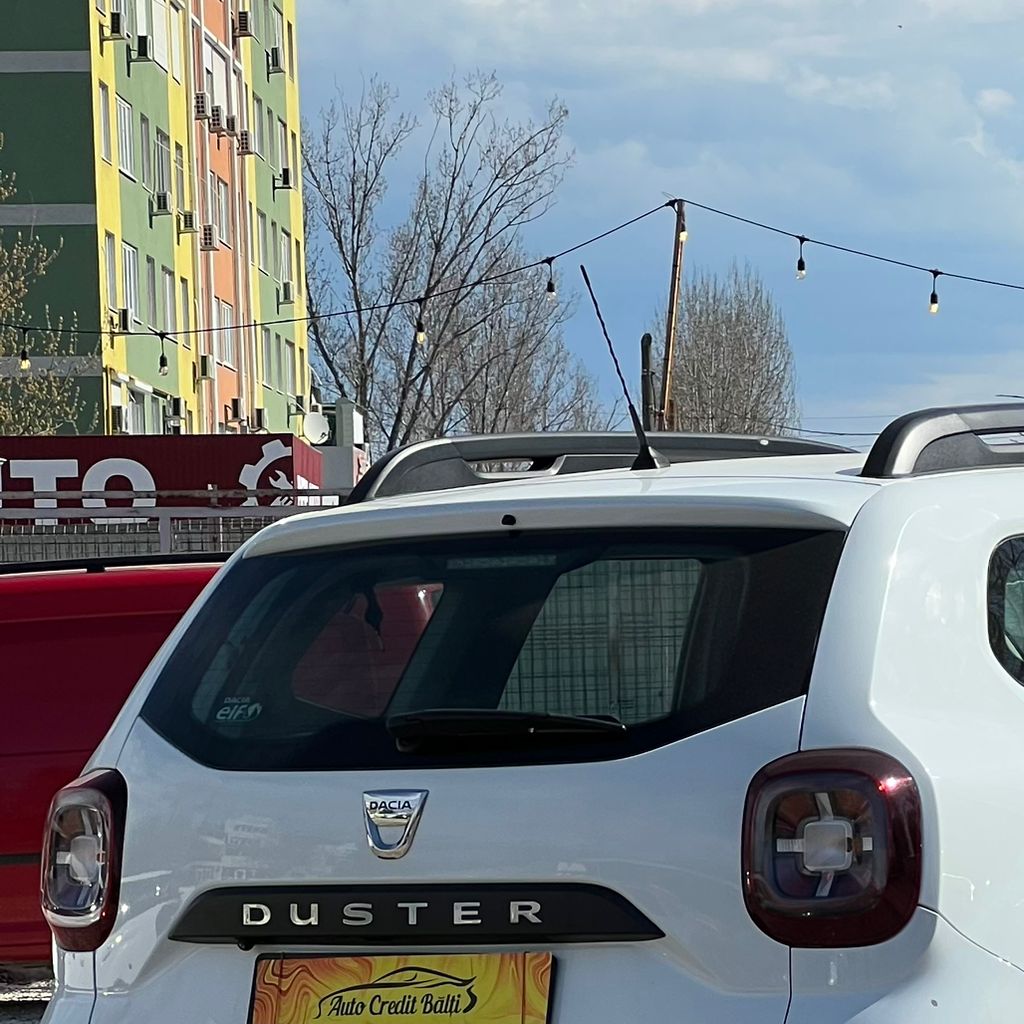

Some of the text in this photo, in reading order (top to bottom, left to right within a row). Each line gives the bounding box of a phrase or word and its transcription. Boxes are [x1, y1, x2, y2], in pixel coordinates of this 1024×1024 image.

[0, 458, 157, 526] TO
[370, 801, 412, 810] DACIA
[242, 901, 543, 926] DUSTER
[328, 996, 366, 1017] Auto
[369, 994, 417, 1015] Credit
